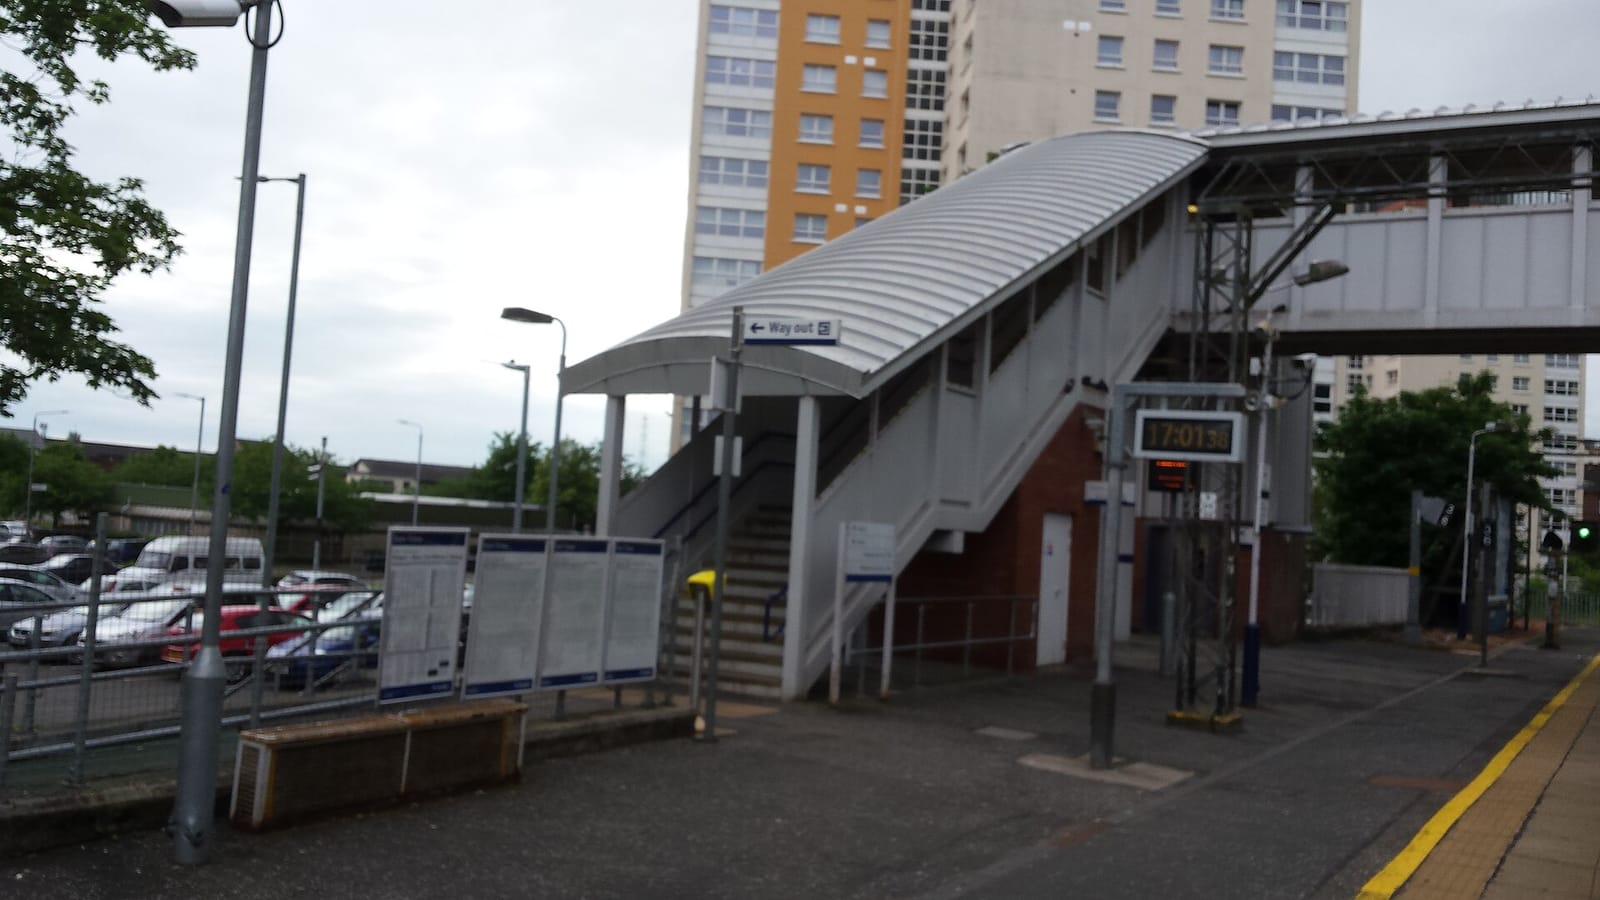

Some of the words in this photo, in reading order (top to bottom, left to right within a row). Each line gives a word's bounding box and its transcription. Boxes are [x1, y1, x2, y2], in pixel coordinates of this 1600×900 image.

[769, 322, 792, 337] Way
[794, 322, 814, 334] out
[1150, 422, 1203, 447] 17:01
